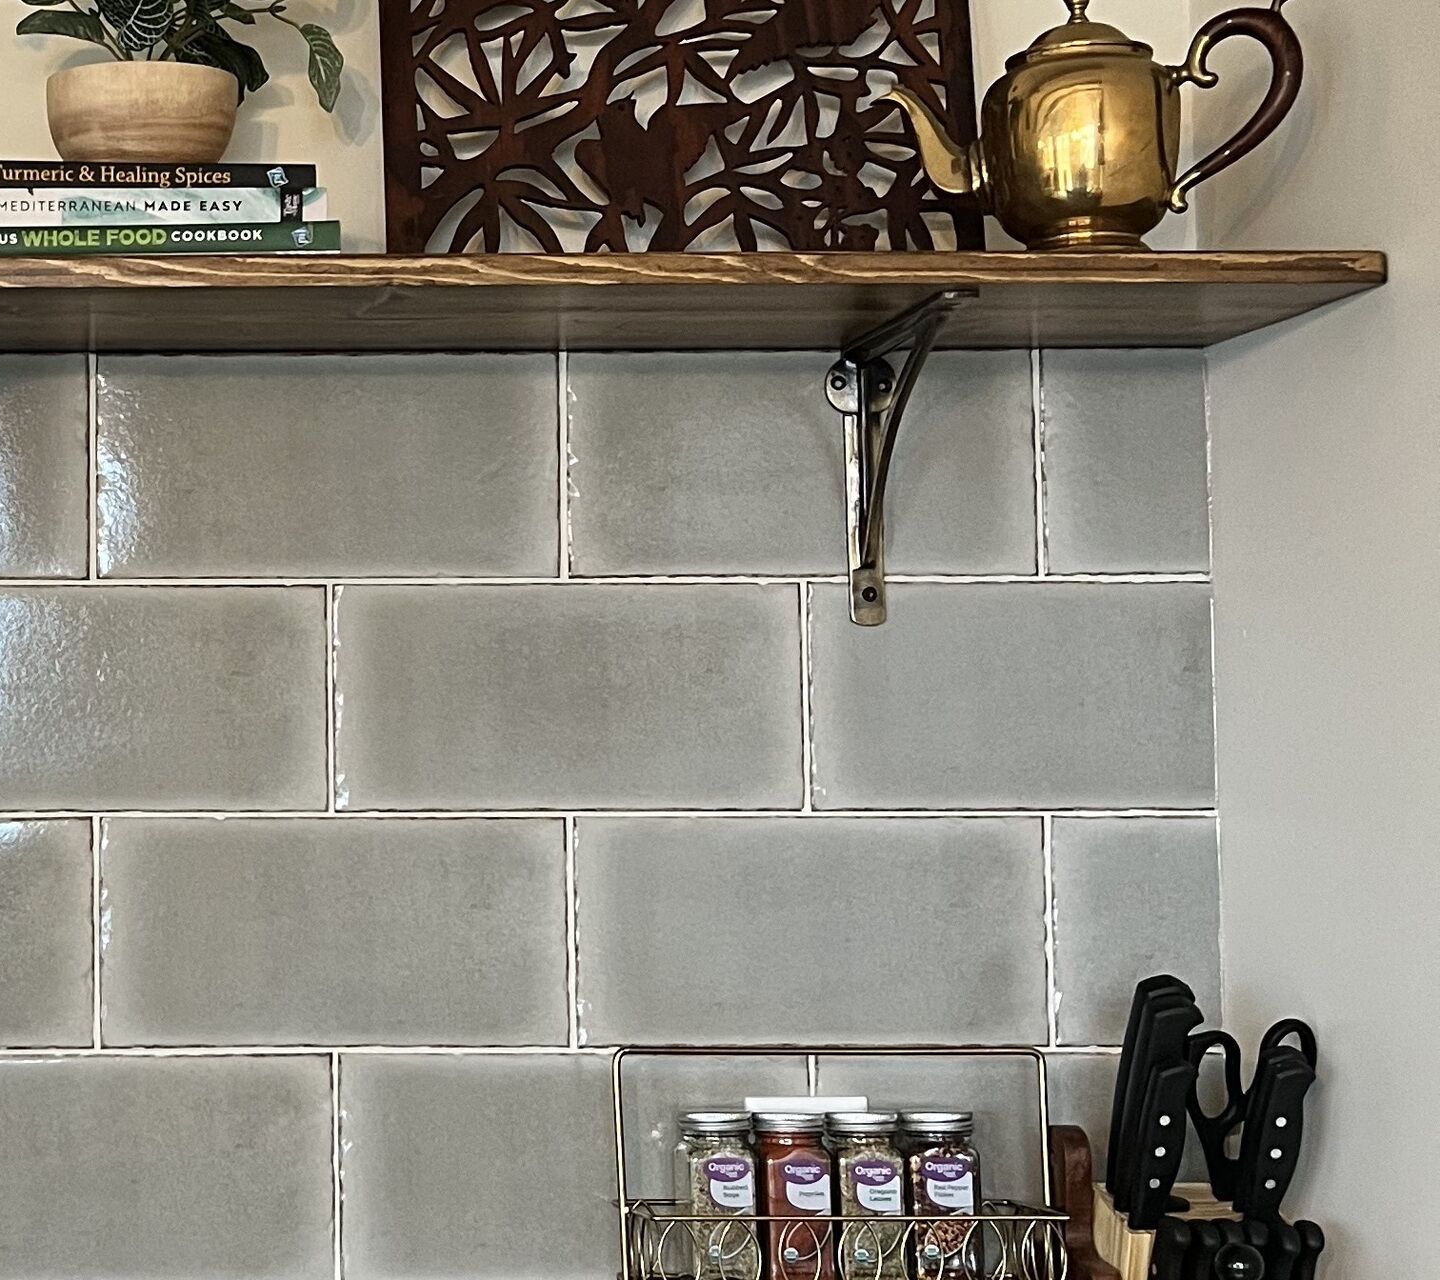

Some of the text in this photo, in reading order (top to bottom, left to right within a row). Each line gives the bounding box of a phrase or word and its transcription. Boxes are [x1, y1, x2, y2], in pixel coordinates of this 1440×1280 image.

[78, 165, 96, 182] &
[101, 165, 171, 187] Healing
[175, 166, 231, 188] Spices
[144, 200, 191, 212] MADE
[199, 200, 243, 212] EASY
[21, 229, 100, 247] WHOLE
[106, 228, 167, 246] FOOD
[171, 229, 263, 242] COOKBOOK
[708, 1163, 745, 1174] Organic
[784, 1164, 821, 1177] Organic
[854, 1166, 892, 1178] Organic
[924, 1161, 964, 1173] Organic
